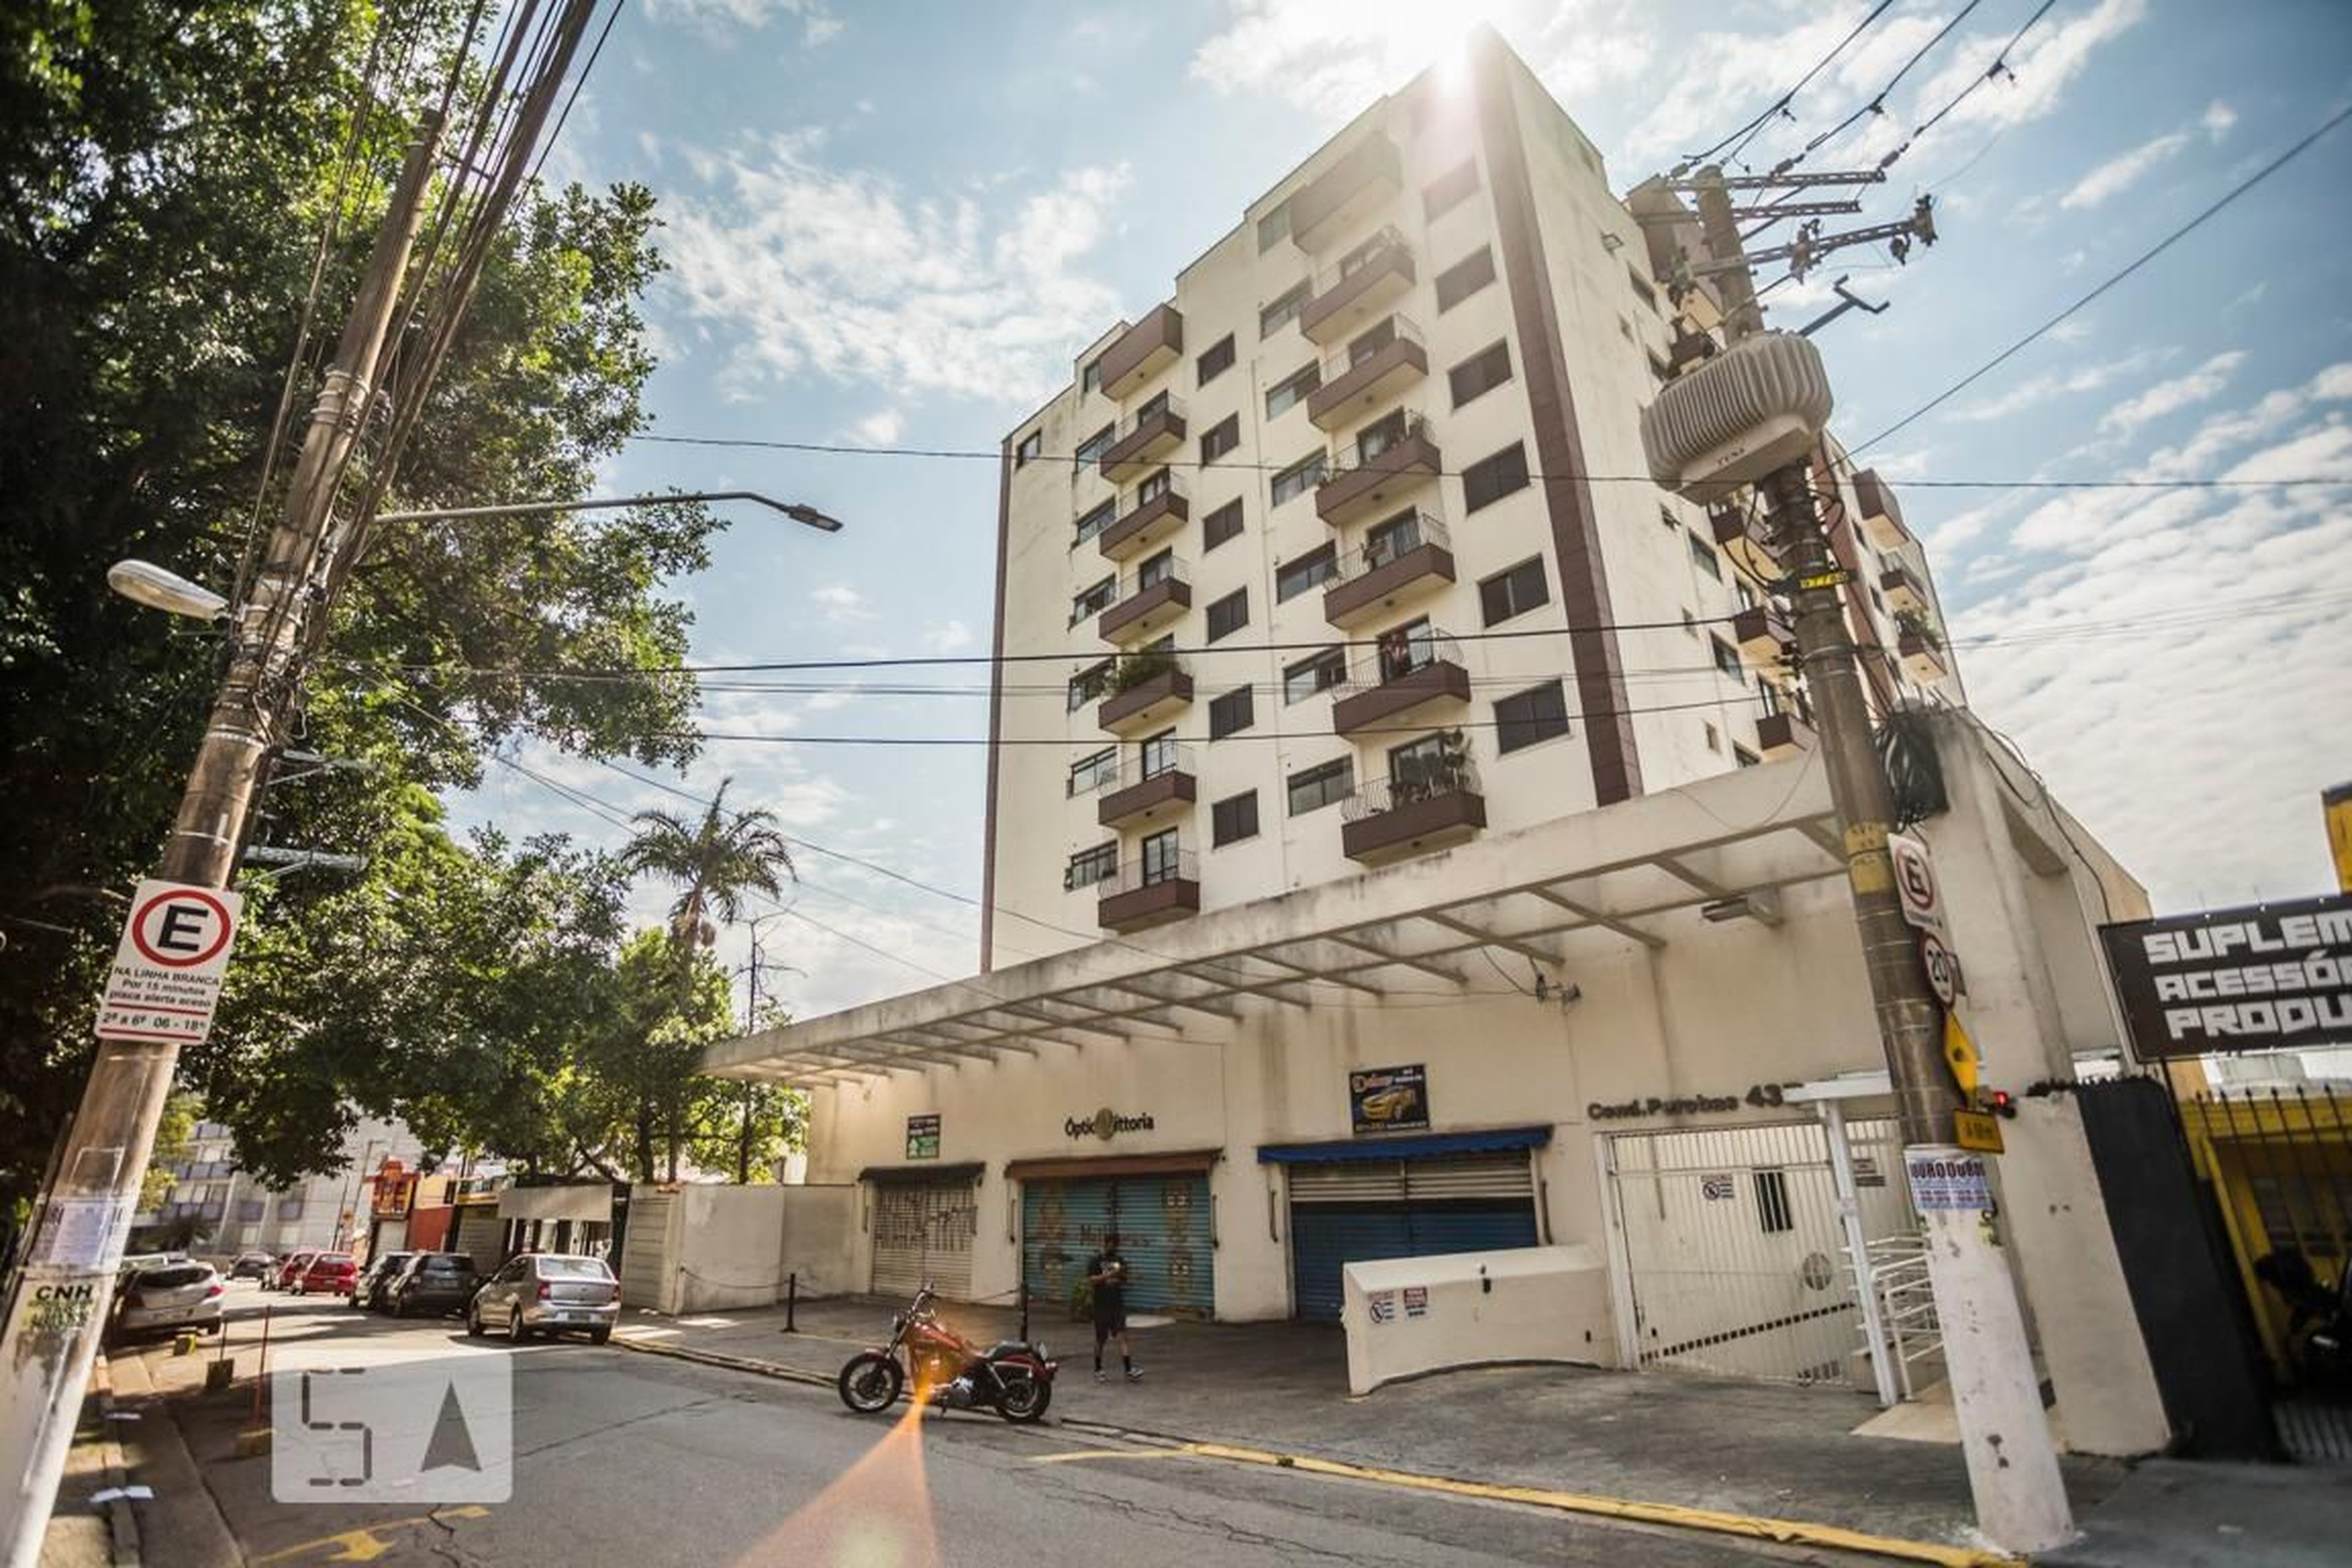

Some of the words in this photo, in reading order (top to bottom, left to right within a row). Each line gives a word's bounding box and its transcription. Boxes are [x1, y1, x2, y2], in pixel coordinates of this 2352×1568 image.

[157, 903, 209, 952] E
[2143, 909, 2352, 964] SUPLEM
[114, 967, 131, 976] NA
[134, 969, 168, 980] LINHA
[172, 972, 219, 986] BRANCA
[123, 979, 141, 989] Por
[146, 981, 159, 990] 15
[144, 993, 176, 1004] alerta
[121, 1016, 128, 1025] a
[153, 1017, 170, 1028] 06
[36, 1284, 92, 1300] CNH
